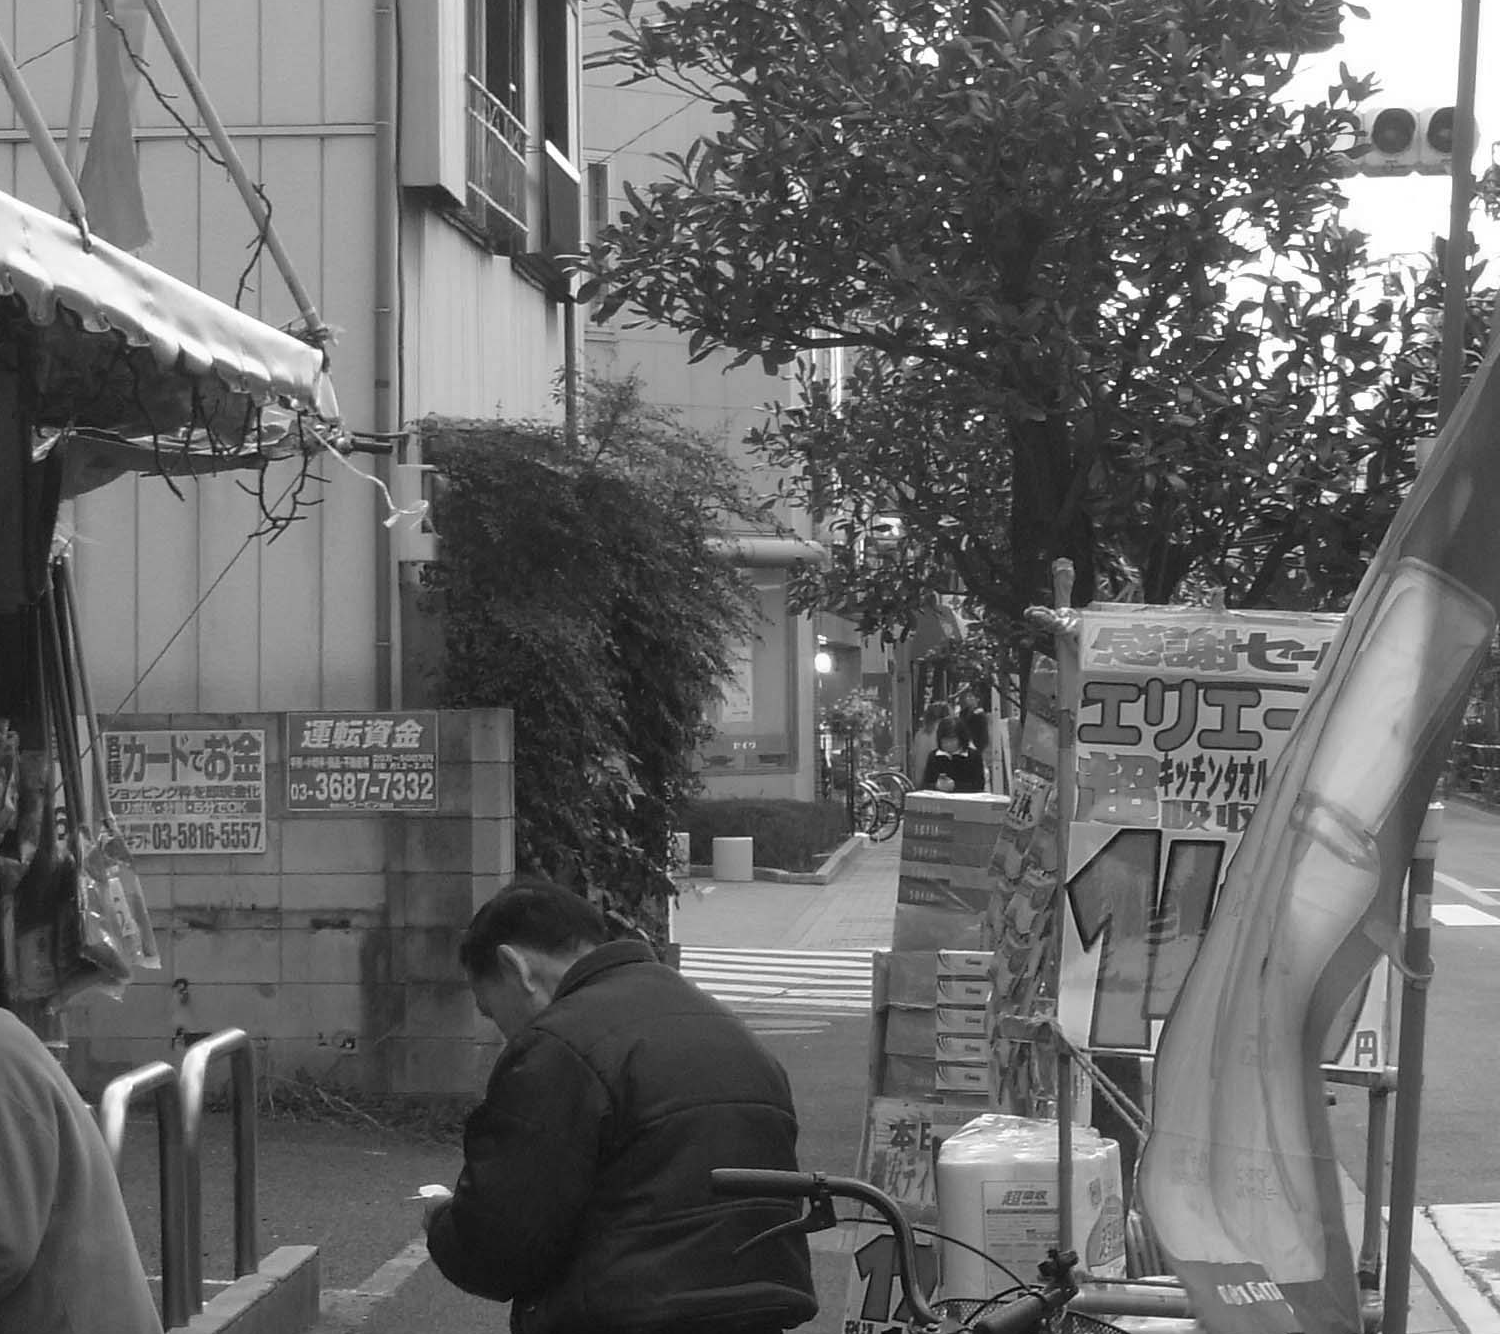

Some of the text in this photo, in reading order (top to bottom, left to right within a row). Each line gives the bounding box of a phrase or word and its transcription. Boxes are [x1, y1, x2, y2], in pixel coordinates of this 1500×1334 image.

[301, 719, 425, 748] 運転資金
[290, 772, 435, 801] 03-3687-7332
[153, 821, 262, 851] 03-5816-5557
